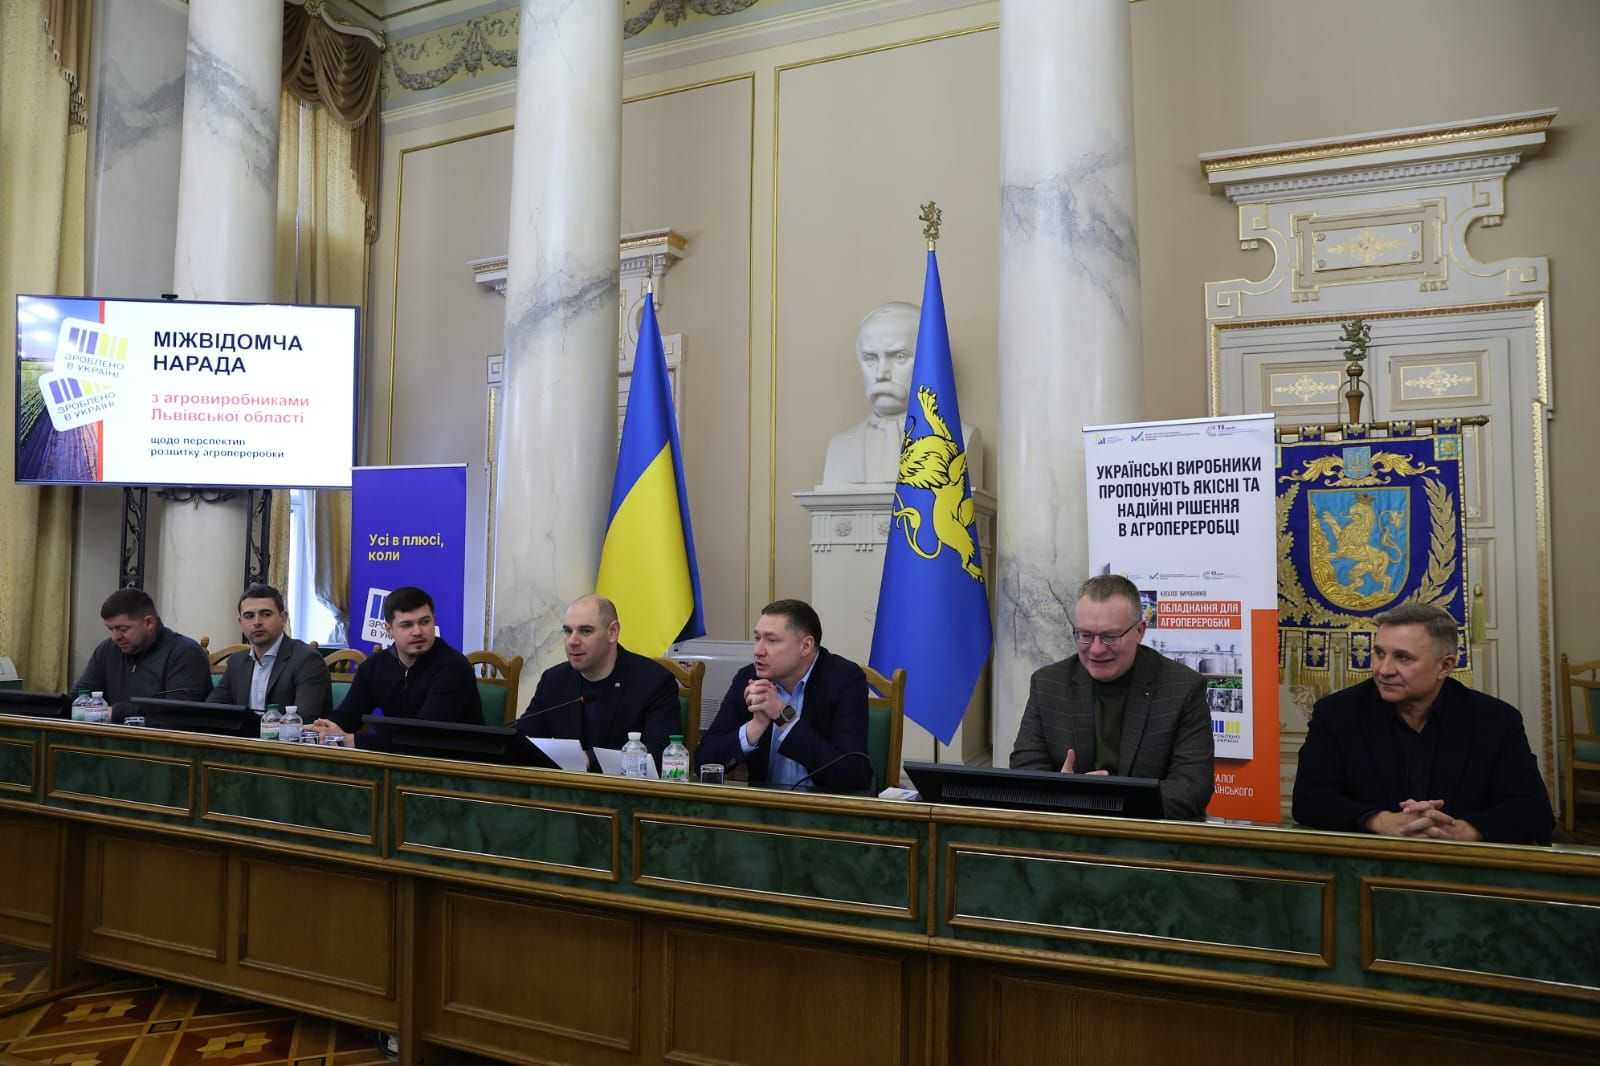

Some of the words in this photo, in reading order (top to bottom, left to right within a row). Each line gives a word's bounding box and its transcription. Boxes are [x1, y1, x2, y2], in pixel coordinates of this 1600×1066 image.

[154, 331, 303, 351] МІЖВІДОМЧА
[64, 353, 124, 370] ЗРОБЛЕНО
[153, 355, 246, 375] НАРАДА
[57, 392, 116, 413] ЗРОБЛЕНО
[151, 393, 159, 404] з
[164, 393, 309, 410] агровиробниками
[151, 408, 239, 423] Львівської
[244, 411, 304, 424] області
[150, 436, 180, 446] щодо
[183, 437, 246, 447] перспектив
[150, 448, 199, 459] розвитку
[203, 448, 285, 460] агропереробки
[1096, 461, 1173, 480] УКРАЇНСЬКІ
[1177, 456, 1262, 475] ВИРОБНИКИ
[1099, 480, 1190, 499] ПРОПОНУЮТЬ
[1194, 478, 1239, 495] ЯКІСНІ
[1243, 477, 1260, 493] ТА
[1117, 499, 1173, 518] НАДІЙНІ
[1177, 498, 1240, 516] РІШЕННЯ
[1119, 523, 1127, 537] В
[1131, 519, 1240, 537] АГРОПЕРЕРОБЦІ
[369, 533, 389, 546] Усі
[392, 536, 399, 546] в
[402, 533, 445, 548] плюсі,
[368, 551, 400, 561] коли
[1160, 602, 1218, 614] ОБЛАДНАННЯ
[1220, 603, 1239, 614] ДЛЯ
[1160, 617, 1230, 628] АГРОПЕРЕРОБКИ
